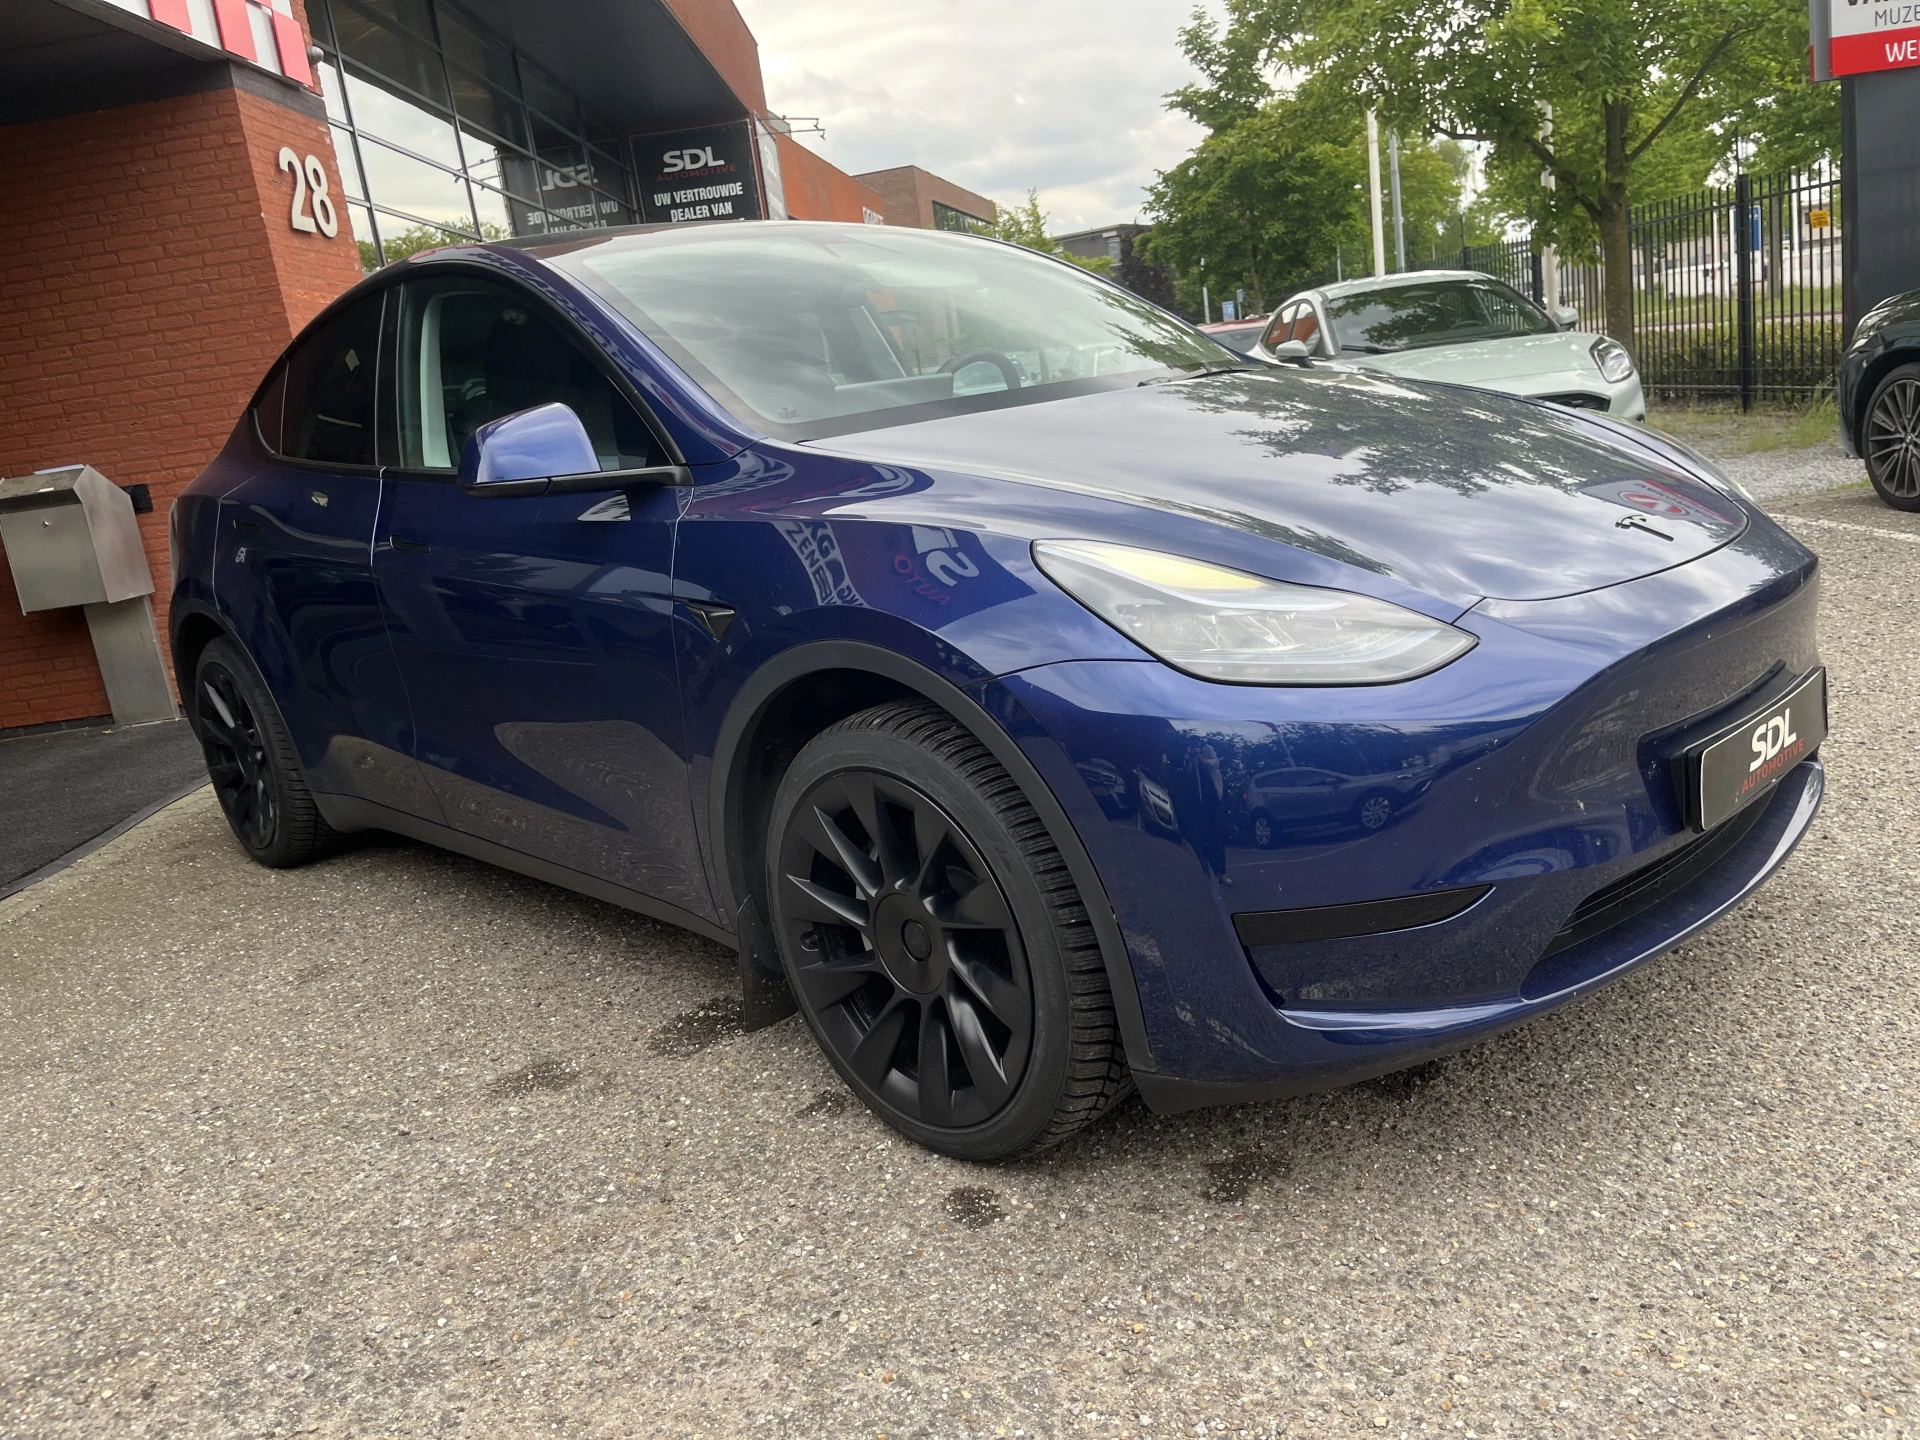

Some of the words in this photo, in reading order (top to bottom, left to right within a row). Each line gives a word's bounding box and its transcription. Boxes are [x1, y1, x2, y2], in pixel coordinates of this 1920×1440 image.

[1885, 40, 1920, 63] WE
[657, 163, 736, 182] AUTOMOTIVE
[663, 146, 726, 173] SDL
[279, 147, 338, 238] 28
[654, 193, 671, 207] UW
[673, 182, 744, 204] VERTROUWDE
[670, 205, 710, 222] DEALER
[711, 201, 733, 217] VAN
[1749, 708, 1797, 773] SDL
[1741, 738, 1804, 794] AUTOMOTIVE
